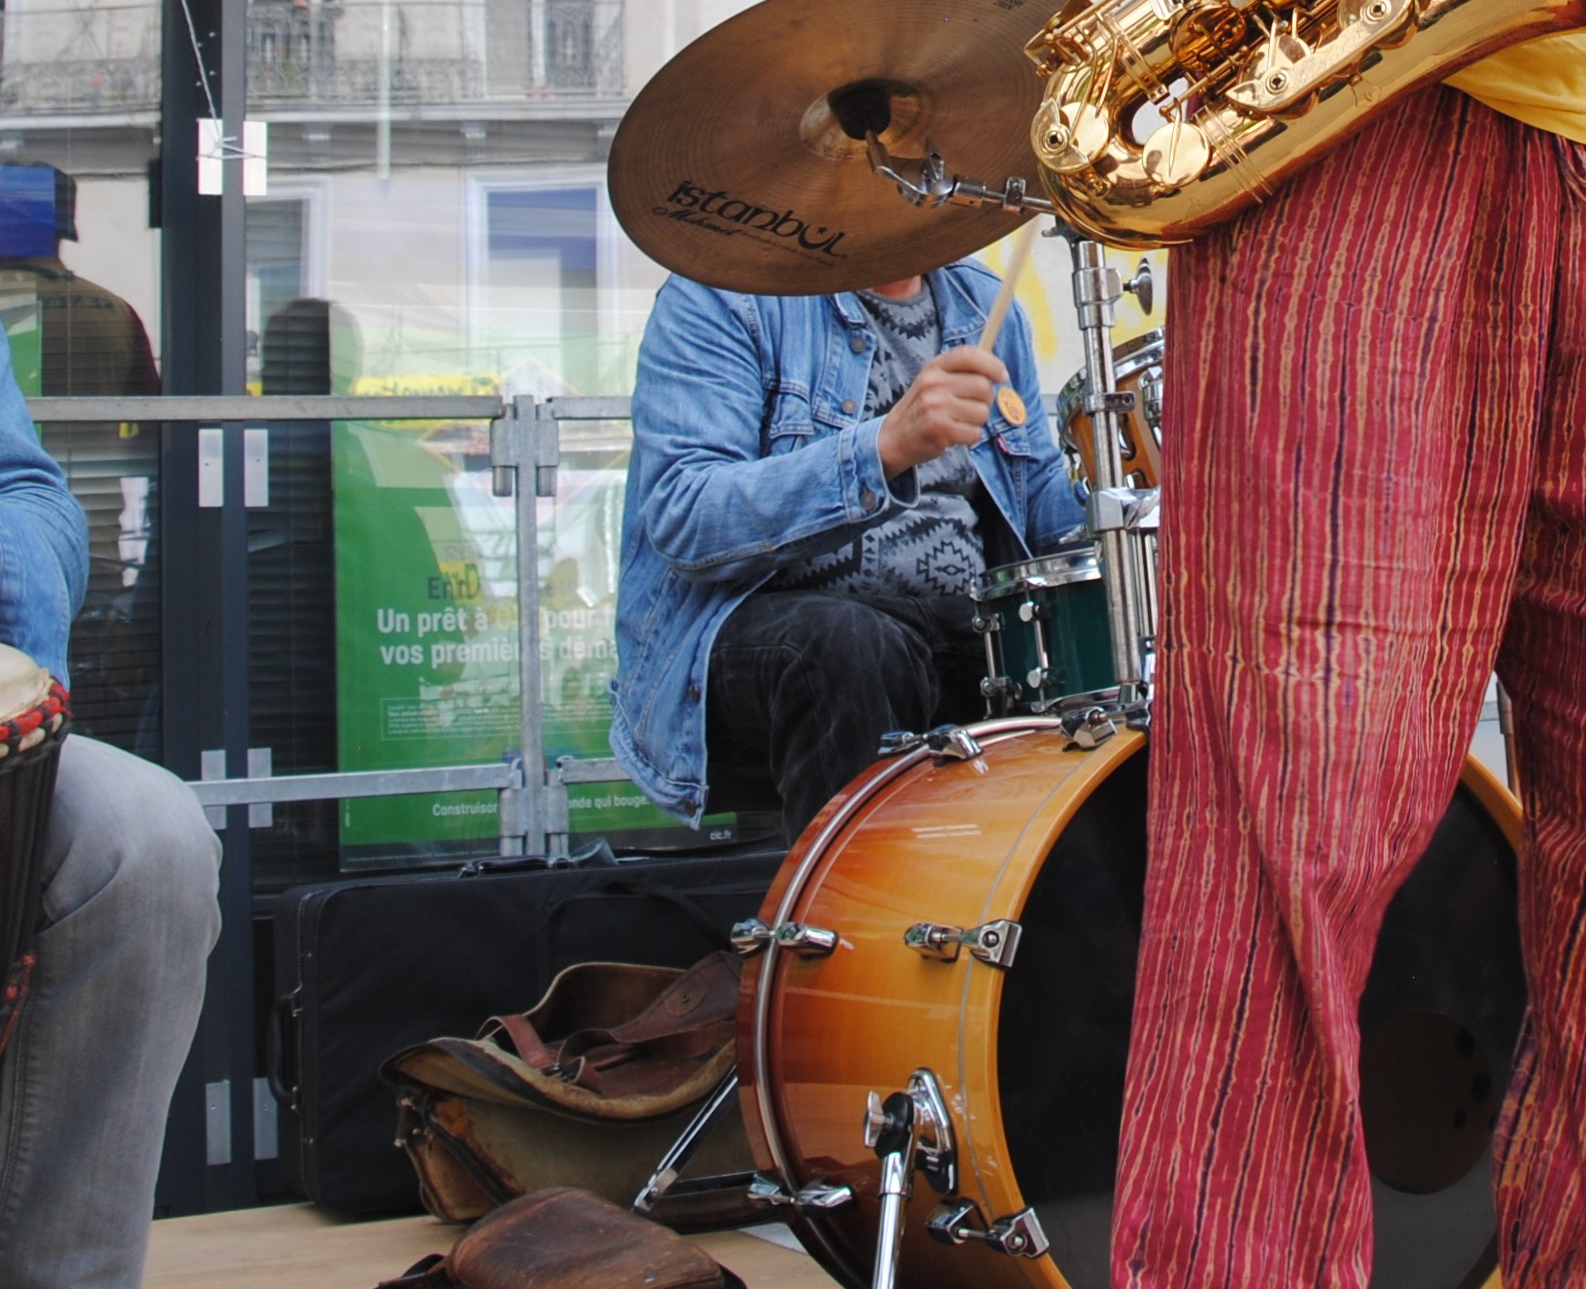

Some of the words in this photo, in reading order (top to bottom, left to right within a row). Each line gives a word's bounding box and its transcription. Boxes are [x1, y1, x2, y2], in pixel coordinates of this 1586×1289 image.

[377, 608, 410, 634] Un
[417, 606, 468, 638] prêt
[474, 607, 489, 632] à
[380, 644, 424, 665] vos
[594, 794, 612, 810] qui
[613, 793, 651, 809] bouge.
